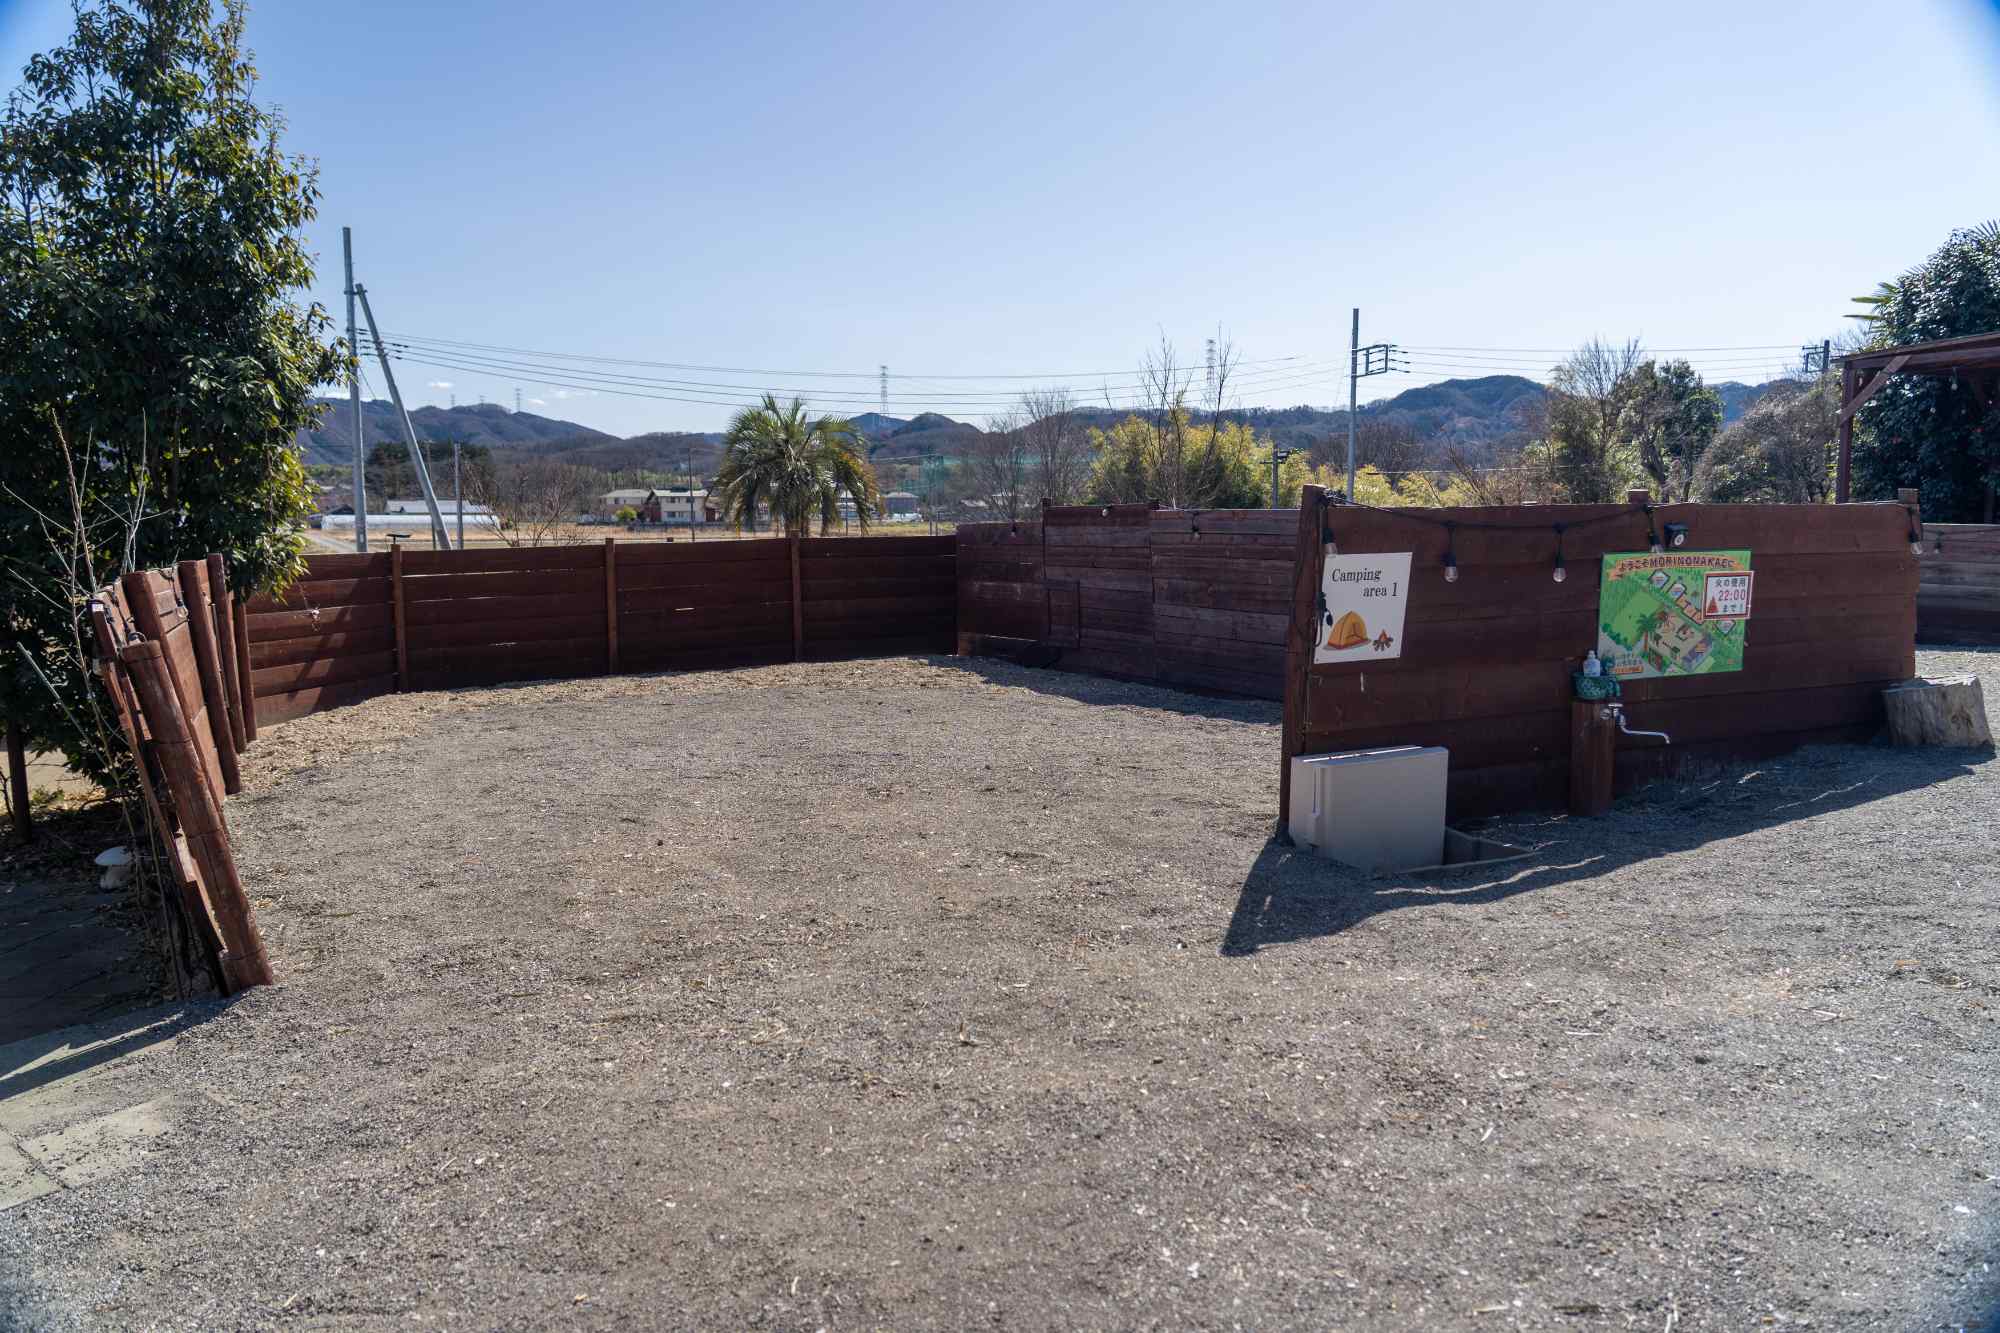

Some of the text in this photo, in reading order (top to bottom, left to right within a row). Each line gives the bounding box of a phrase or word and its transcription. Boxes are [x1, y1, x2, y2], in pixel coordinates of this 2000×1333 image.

[1332, 568, 1382, 583] Camping
[1363, 582, 1398, 597] area 1
[1718, 589, 1746, 601] 22:00
